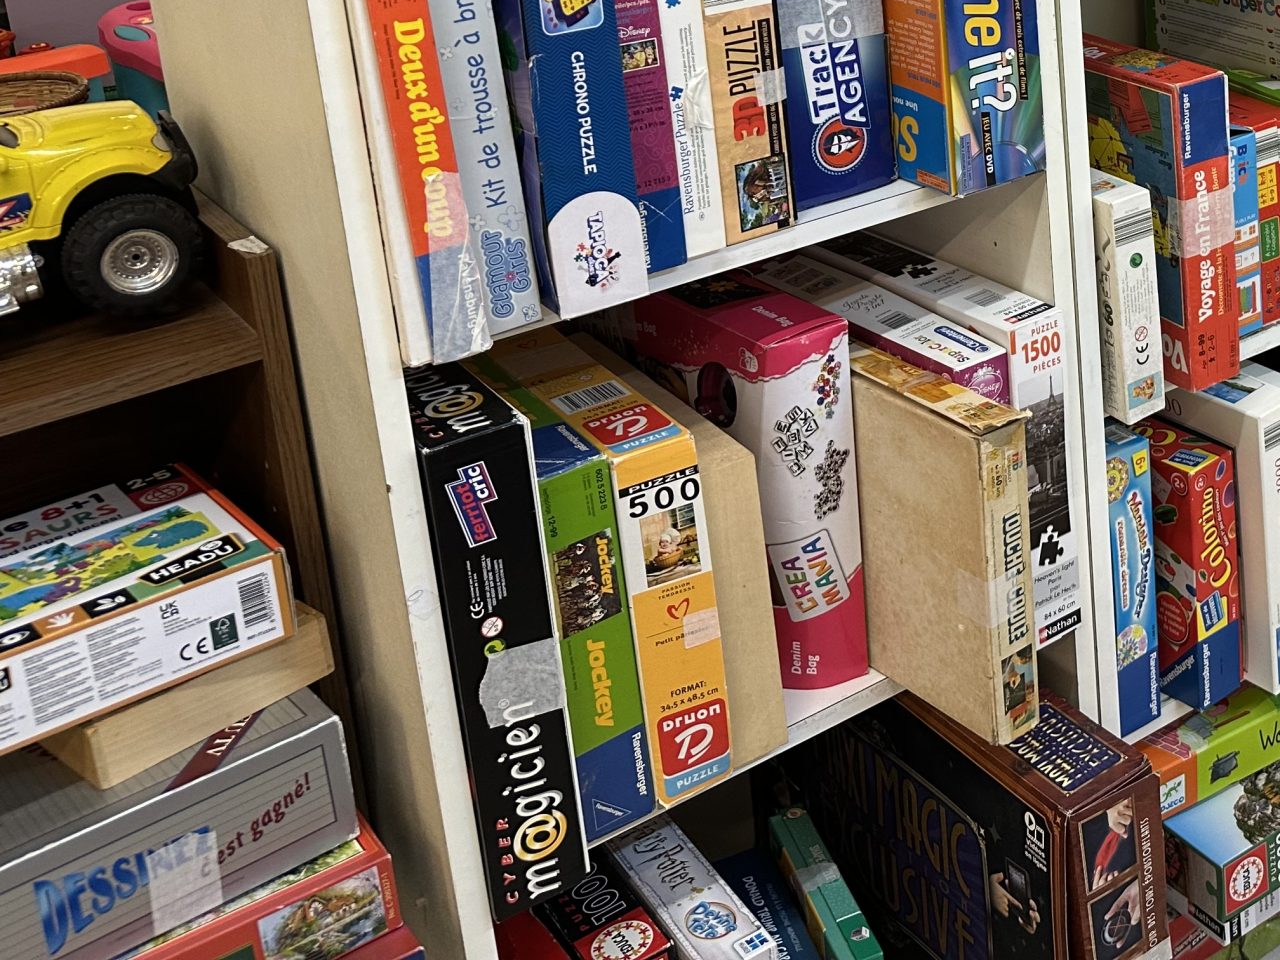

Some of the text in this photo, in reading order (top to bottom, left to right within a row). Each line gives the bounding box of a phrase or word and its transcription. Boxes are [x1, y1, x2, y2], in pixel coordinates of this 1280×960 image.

[454, 31, 481, 48] à
[723, 20, 766, 141] 3D PUZZLE
[802, 26, 838, 118] Track
[466, 53, 495, 134] trousse
[571, 51, 597, 174] CHRONO PUZZLE
[393, 17, 454, 237] Deux d'un coup
[982, 117, 994, 173] JEU AVEC DVD
[1182, 93, 1192, 160] Ravensburger
[477, 142, 500, 169] de
[673, 102, 695, 215] Ravensburger Puzzle
[484, 178, 507, 208] Kit
[1193, 170, 1216, 323] Voyage en France
[752, 305, 794, 328] Denim Bag
[1031, 320, 1058, 337] PUZZLE
[1022, 332, 1061, 364] 1500
[1033, 357, 1061, 374] PIÈCES
[621, 431, 669, 449] PUZZLE
[126, 470, 172, 489] 2-5
[629, 467, 695, 494] PUZZLE
[629, 477, 700, 519] 500
[40, 494, 105, 521] 8+1
[457, 465, 489, 542] ferriot cric
[1127, 491, 1152, 618] Mandala-Designer
[1200, 488, 1232, 588] Colorino
[150, 543, 234, 581] HEADU
[595, 537, 613, 594] Jockey
[801, 536, 844, 606] MANIA
[1034, 561, 1075, 585] Heaven's light
[658, 585, 695, 600] TENDRESSE
[662, 582, 691, 593] PASSION
[781, 556, 819, 613] CREA
[159, 600, 177, 613] UK
[1044, 611, 1053, 621] 84
[1058, 603, 1067, 614] 60
[1067, 600, 1076, 608] cm
[1045, 615, 1077, 636] Nathan
[791, 641, 801, 675] Denim
[806, 655, 820, 675] Bag
[1202, 643, 1211, 706] Ravensburger
[587, 640, 615, 727] Jockey
[670, 680, 707, 698] FORMAT:
[707, 687, 719, 696] cm
[1149, 652, 1158, 715] Ravensburger
[632, 731, 648, 796] Ravensburger
[676, 764, 720, 790] PUZZLE
[497, 699, 568, 900] m@gicien
[496, 818, 519, 904] CYBER
[656, 843, 695, 891] Potter
[742, 875, 778, 938] DONALD TRUMP
